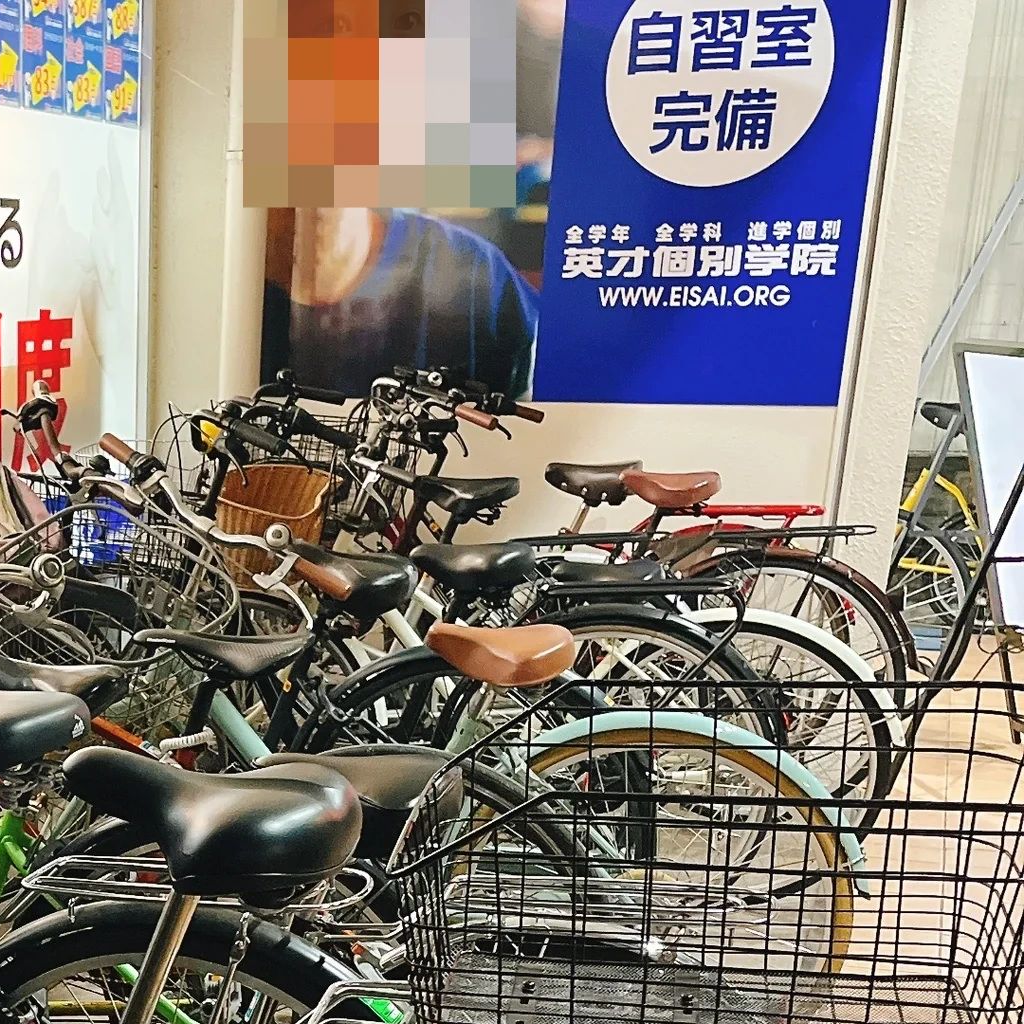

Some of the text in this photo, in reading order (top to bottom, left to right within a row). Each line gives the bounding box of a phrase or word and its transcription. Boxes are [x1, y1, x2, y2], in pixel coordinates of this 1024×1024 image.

[628, 5, 816, 75] 自習室
[649, 88, 777, 154] 完備
[565, 219, 842, 244] 全学年 全学科 進学個別
[562, 243, 839, 279] 英才個別学院
[599, 285, 791, 307] WWW.EISAI.ORG
